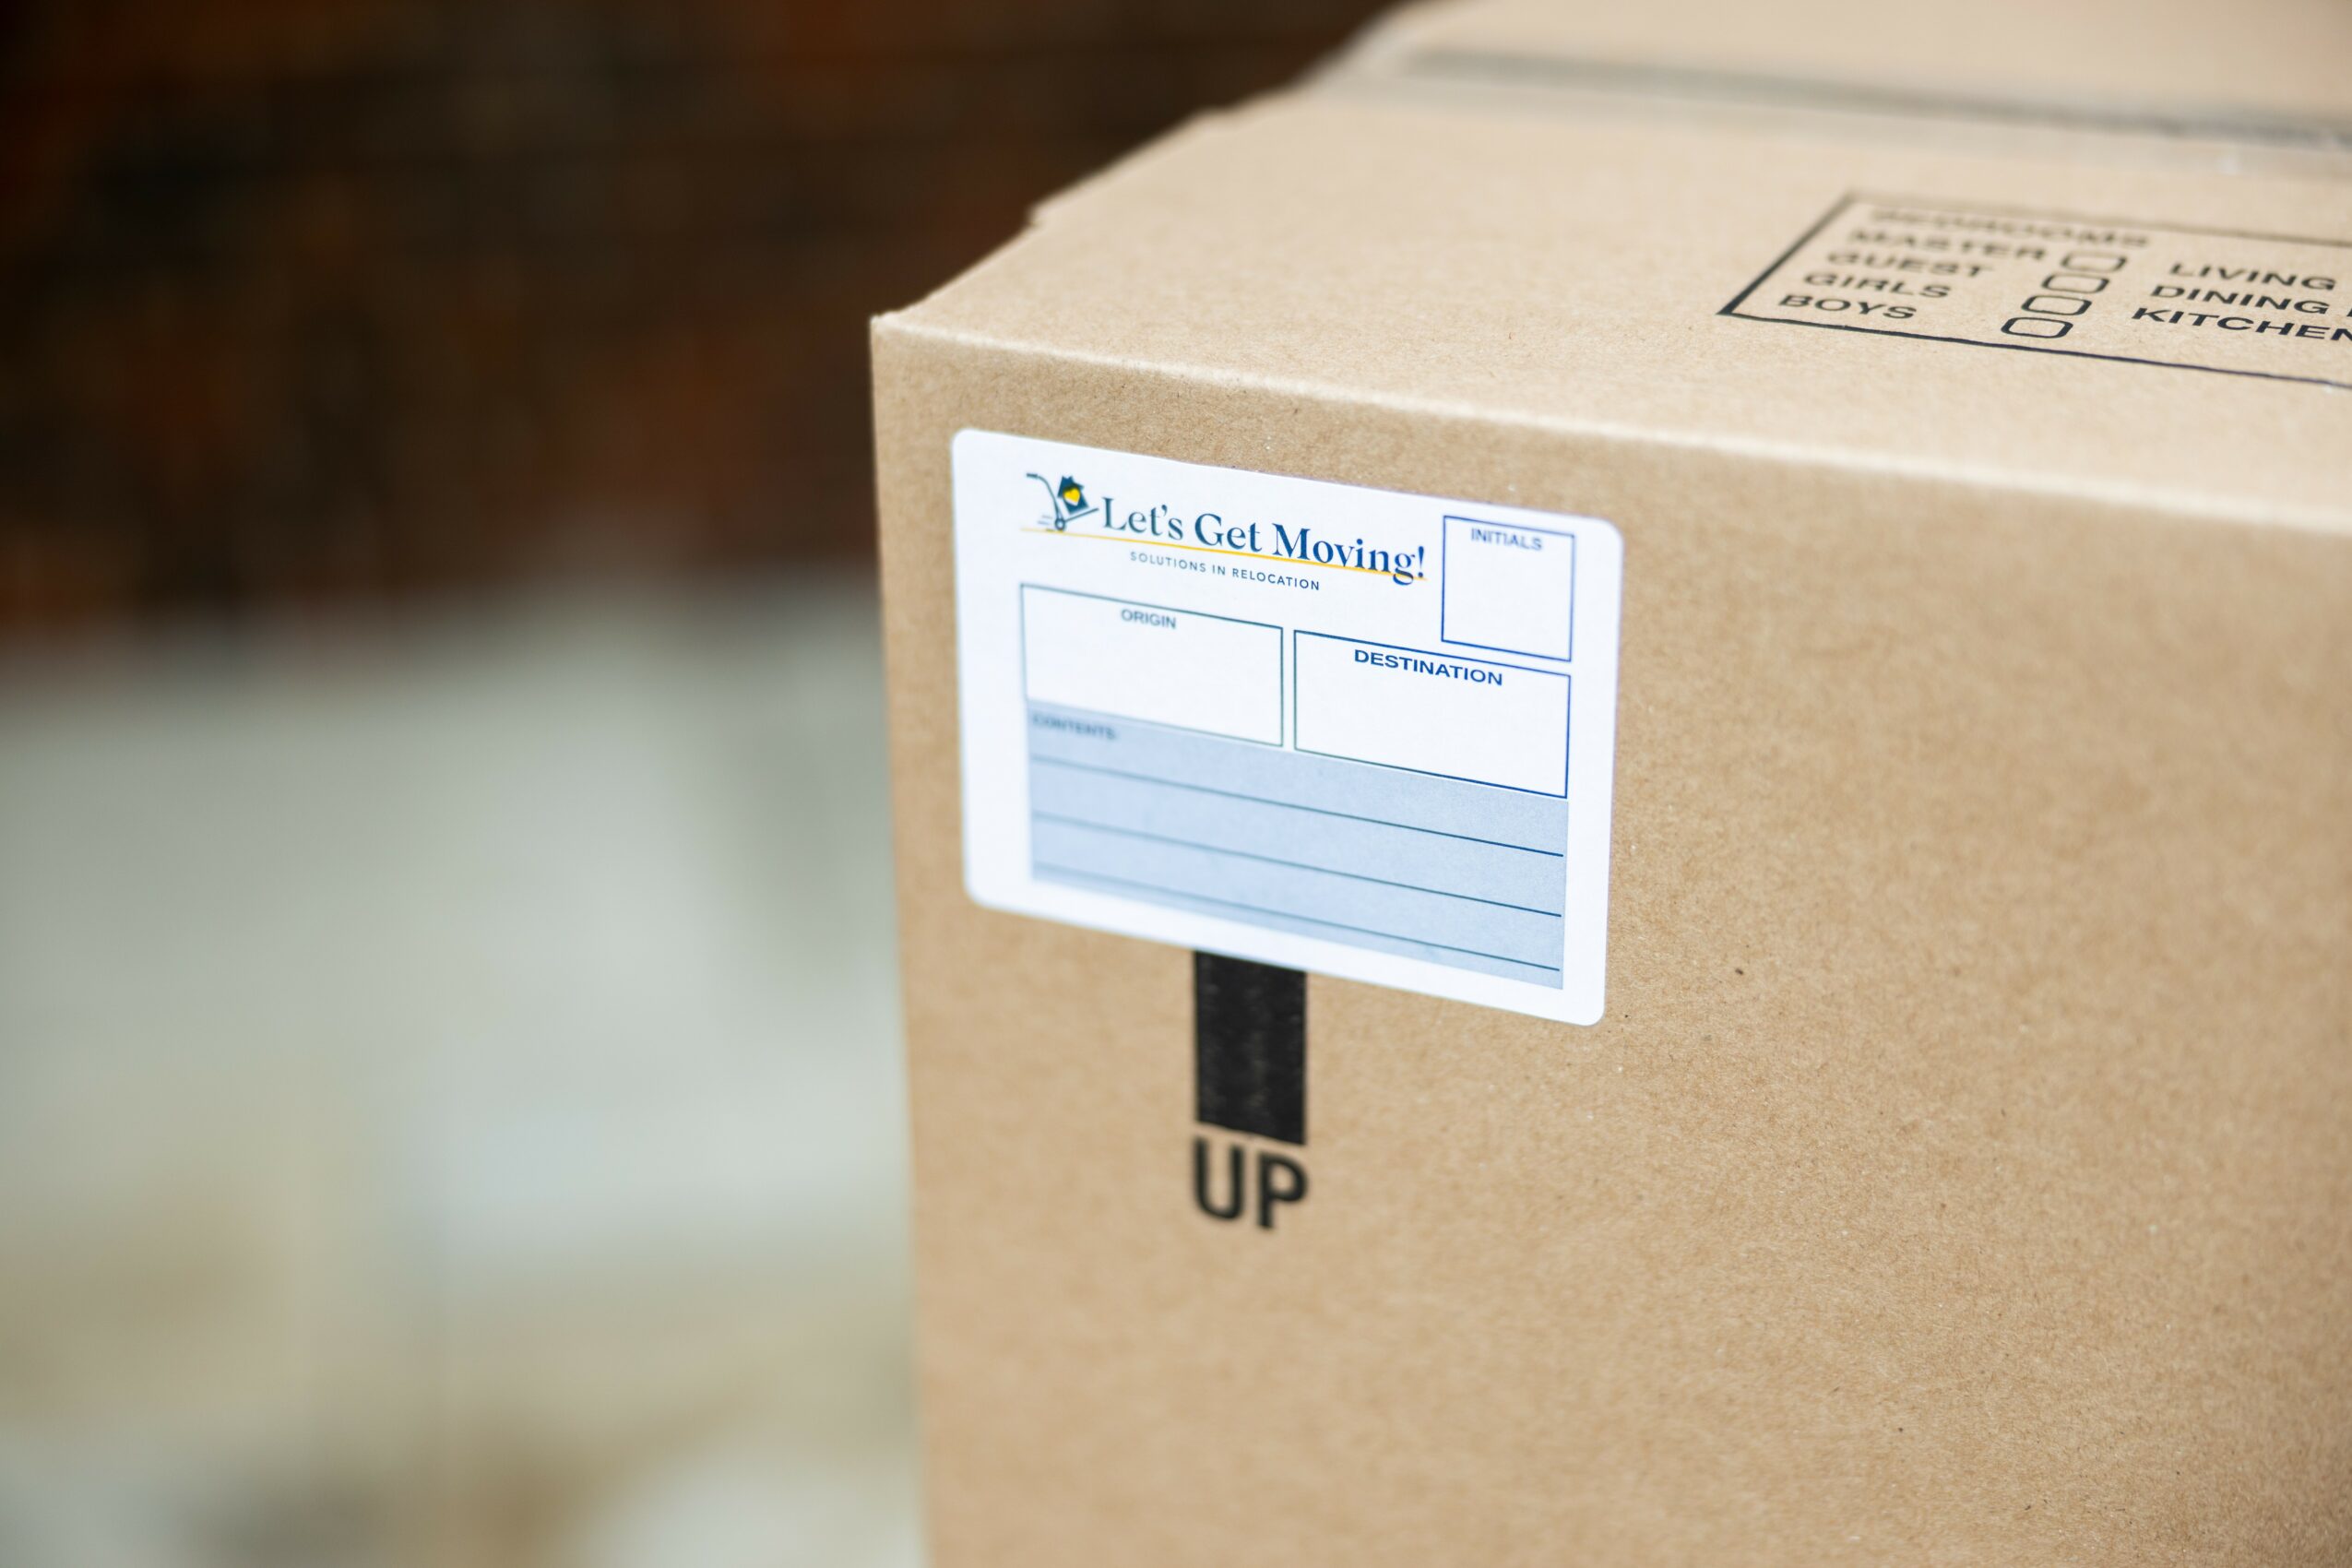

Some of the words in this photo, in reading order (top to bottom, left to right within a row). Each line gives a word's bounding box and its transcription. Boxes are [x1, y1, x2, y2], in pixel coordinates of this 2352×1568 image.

[1846, 226, 2048, 262] MASTER
[1826, 251, 1992, 278] GUEST
[2168, 263, 2338, 291] LIVING
[1802, 272, 1953, 299] GIRLS
[2149, 284, 2332, 315] DINING
[1777, 293, 1918, 320] BOYS
[1102, 496, 1184, 541] Let's
[1194, 512, 1264, 553] Get
[1271, 522, 1427, 587] Moving!
[1470, 527, 1543, 552] INITIALS
[1129, 551, 1207, 574] SOLUTIONS
[1211, 564, 1227, 576] IN
[1231, 567, 1321, 592] RELOCATION
[1120, 608, 1178, 631] ORIGIN
[1353, 648, 1503, 687] DESTINATION
[1030, 712, 1118, 742] CONTENTS
[1191, 1135, 1310, 1232] UP
